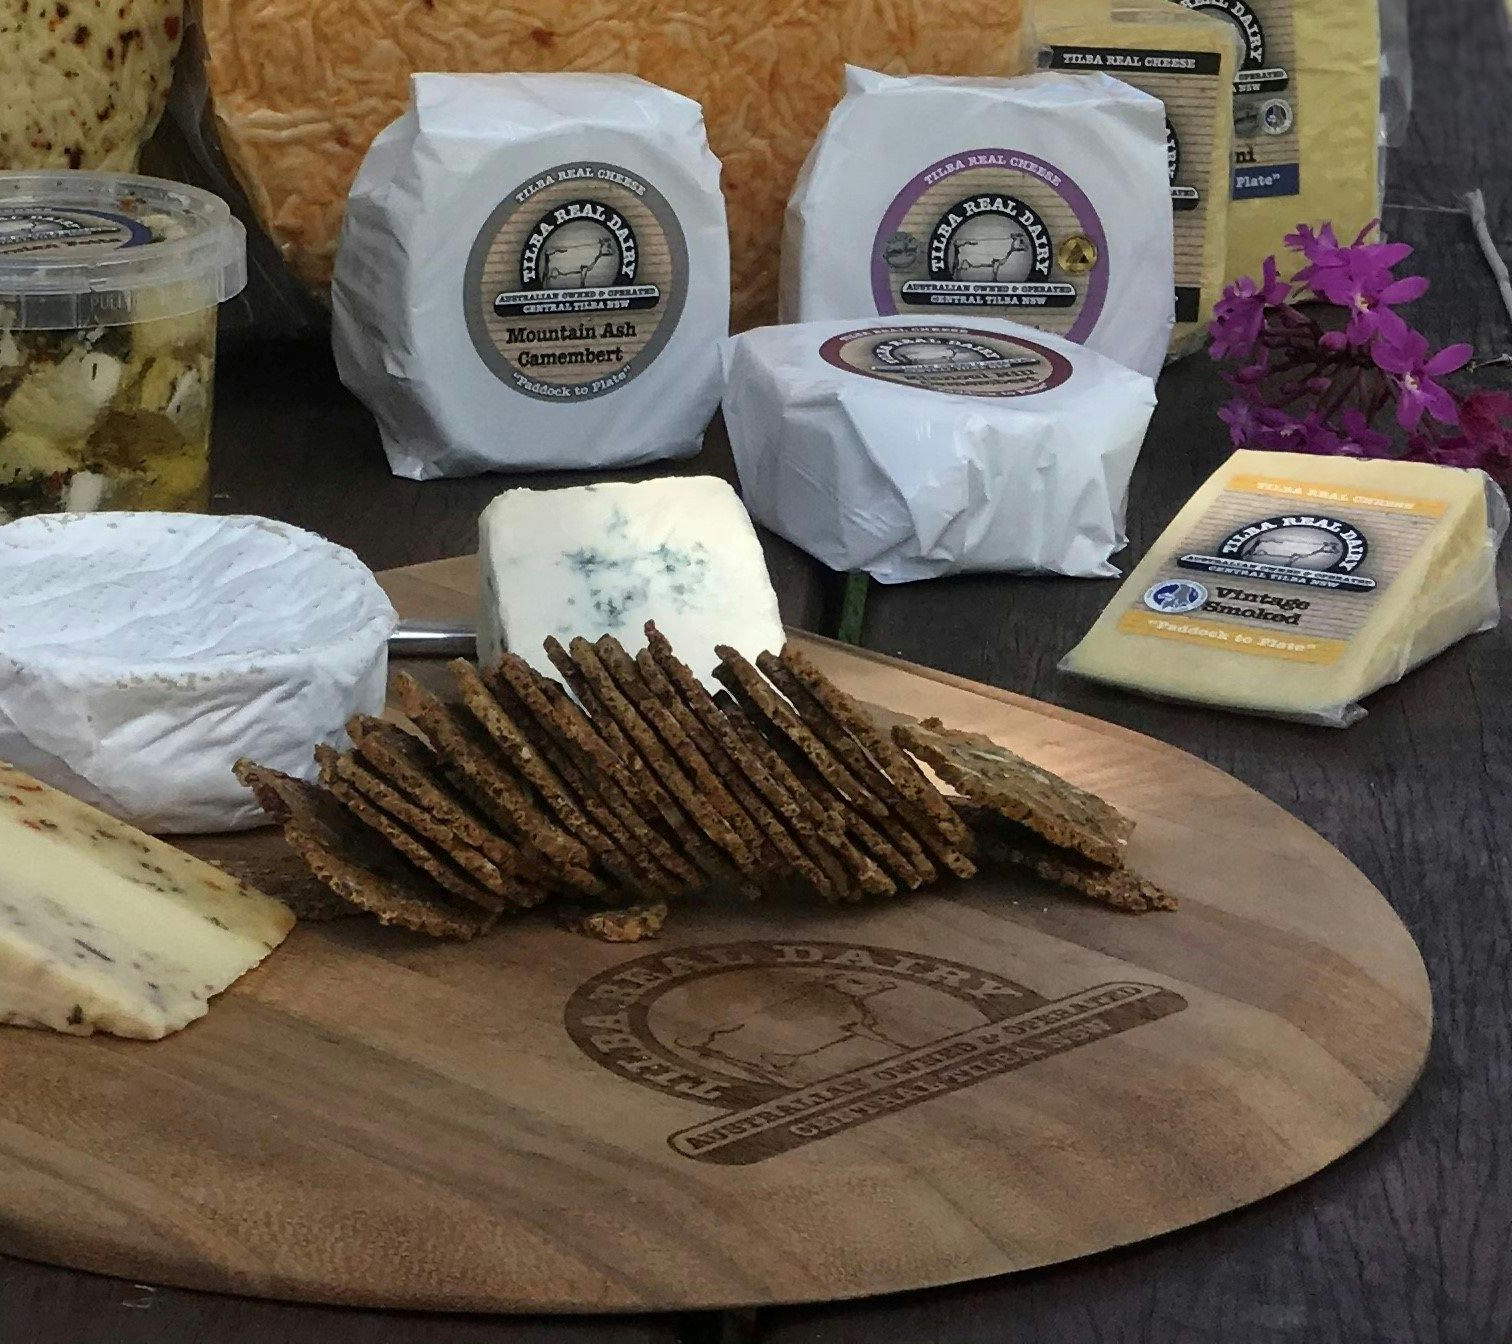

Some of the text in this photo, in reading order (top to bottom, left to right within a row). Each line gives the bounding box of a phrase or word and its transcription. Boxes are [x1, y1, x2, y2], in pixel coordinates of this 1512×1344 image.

[1230, 0, 1264, 63] DAIRY
[1063, 53, 1196, 69] TILBA REAL CHEESE
[923, 154, 1062, 187] TILBA REAL CHEESE
[515, 167, 647, 204] TILBA REAL CHEESE
[523, 203, 636, 283] TILBA REAL DAIRY
[931, 213, 964, 272] TILBA
[963, 197, 1017, 216] REAL
[1018, 209, 1048, 275] DAIRY
[498, 292, 559, 303] AUSTRALIAN
[607, 287, 656, 298] OPERATED
[906, 283, 970, 292] AUSTRALIAN
[1021, 285, 1072, 293] OPERATED
[930, 294, 1047, 305] CENTRAL TILBA NSW
[523, 299, 630, 313] CENTRAL TILBA NSW
[505, 321, 637, 344] Mountain Ash
[517, 346, 623, 368] Camembert
[574, 385, 589, 396] to
[1223, 518, 1278, 553] TILBA
[1282, 516, 1341, 533] REAL
[1339, 530, 1365, 571] DAIRY
[1215, 586, 1311, 611] Vintage
[1202, 601, 1303, 626] Smoked
[1234, 634, 1253, 645] to
[581, 944, 1024, 1101] TILBA REAL DAIRY
[685, 1074, 866, 1152] AUSTRALIAN
[872, 1041, 979, 1087] OWNED
[1004, 984, 1148, 1037] OPERATED
